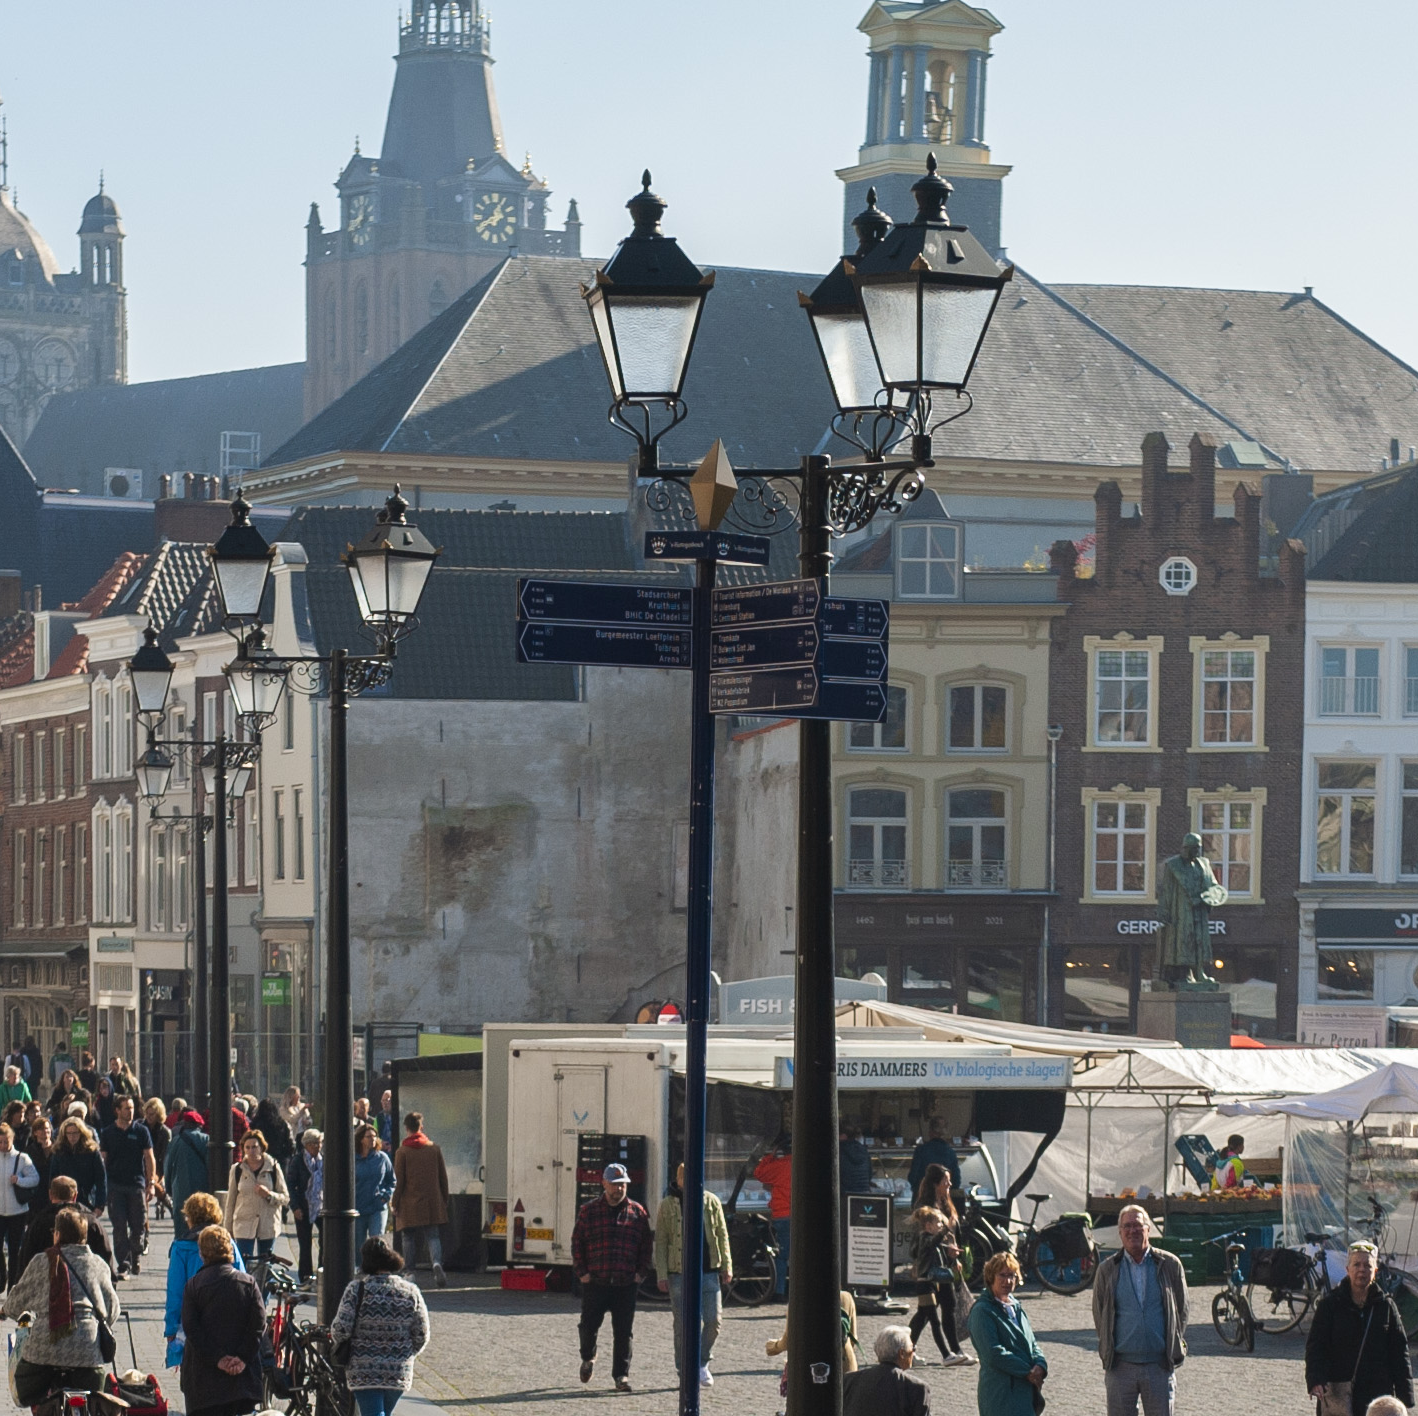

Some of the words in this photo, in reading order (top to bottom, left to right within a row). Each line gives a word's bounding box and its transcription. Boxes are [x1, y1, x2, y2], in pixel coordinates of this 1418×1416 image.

[636, 589, 681, 600] Stadsarchief
[648, 601, 681, 610] Kruithuis
[656, 611, 681, 621] Citadel
[595, 630, 644, 641] Burgemeester
[659, 655, 680, 664] Arena
[1117, 920, 1165, 934] GERR
[739, 999, 781, 1014] FISH
[1330, 1033, 1369, 1048] Perron
[837, 1063, 858, 1077] RIS
[861, 1062, 927, 1077] DAMMERS
[934, 1062, 952, 1077] Uw
[956, 1061, 1023, 1080] biologische
[1025, 1061, 1065, 1080] slager!
